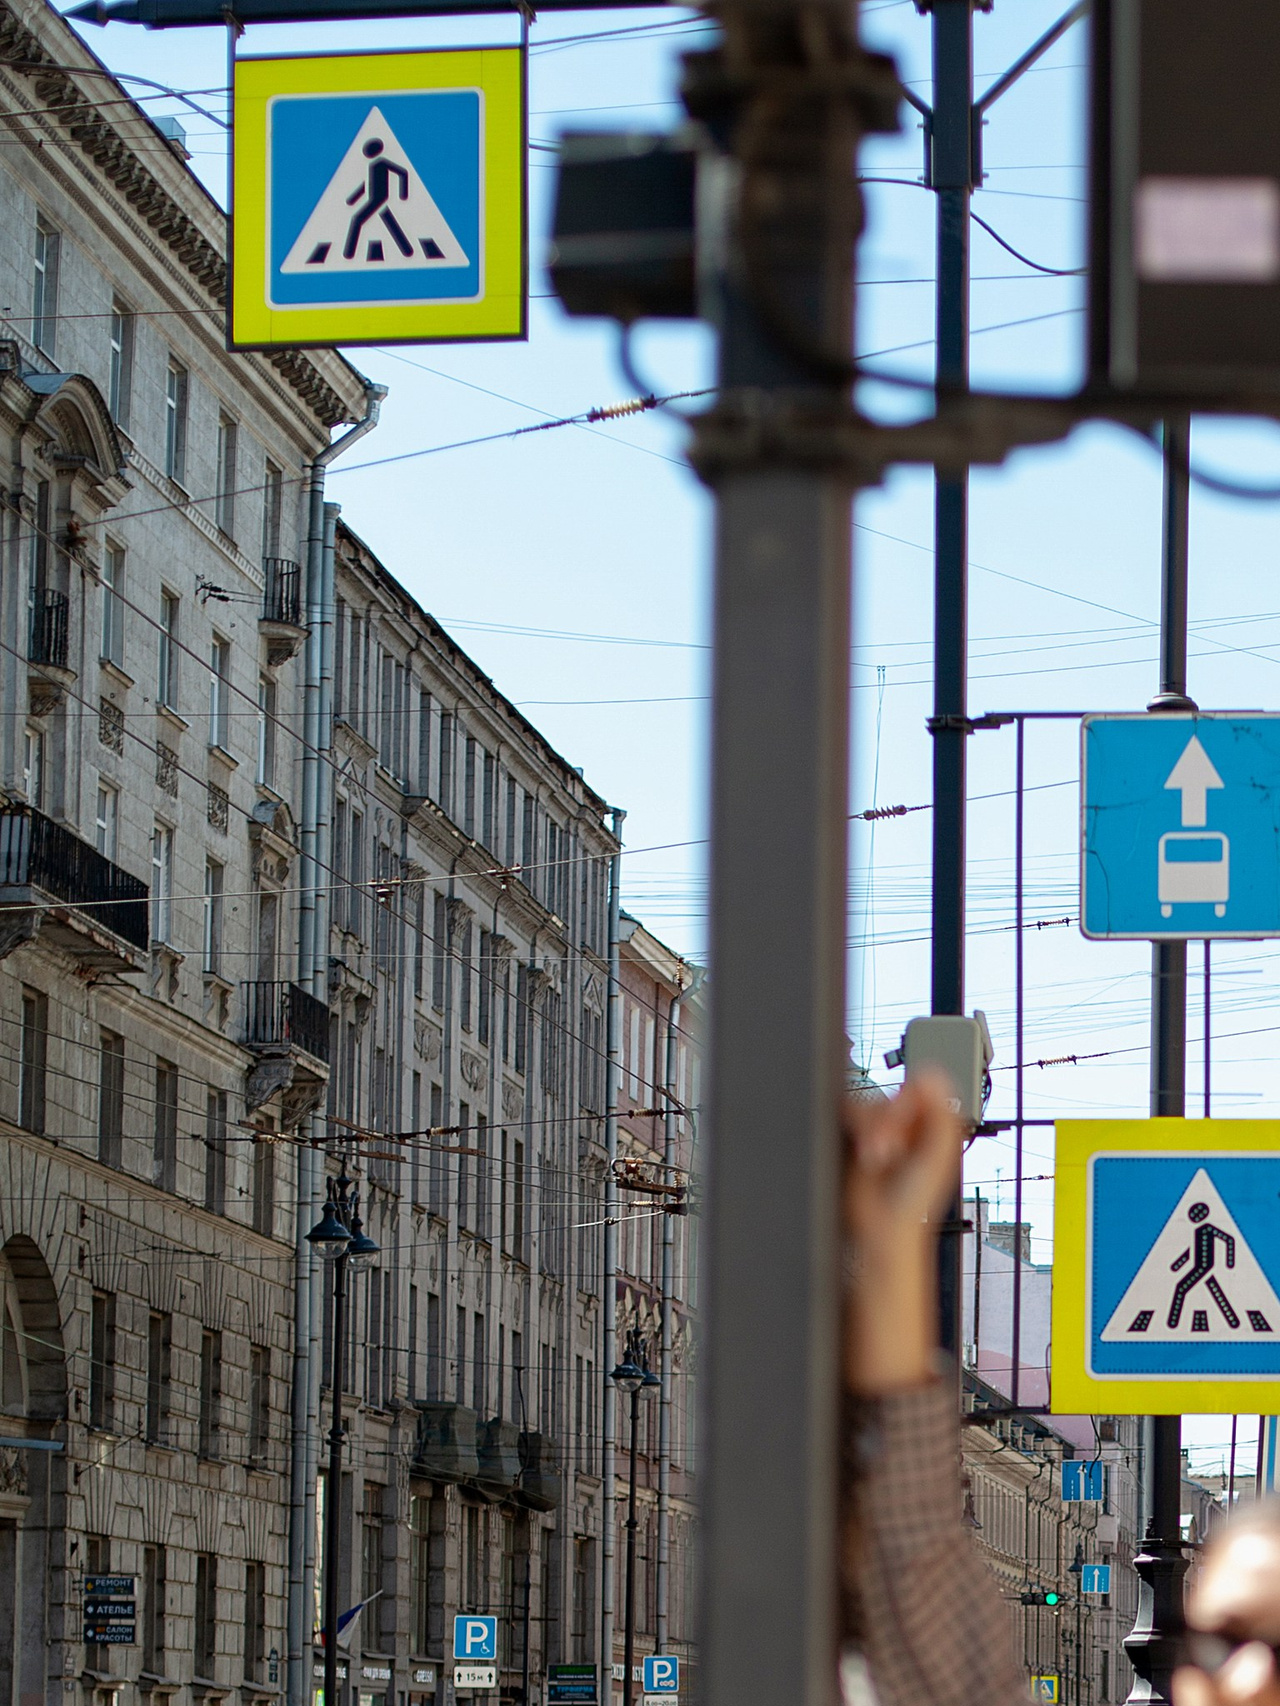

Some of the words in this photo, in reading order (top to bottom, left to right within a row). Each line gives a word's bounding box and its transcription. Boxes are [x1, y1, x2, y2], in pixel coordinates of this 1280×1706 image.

[96, 1605, 133, 1614] АТЕЛЬЕ
[466, 1621, 488, 1654] P
[653, 1660, 672, 1688] P
